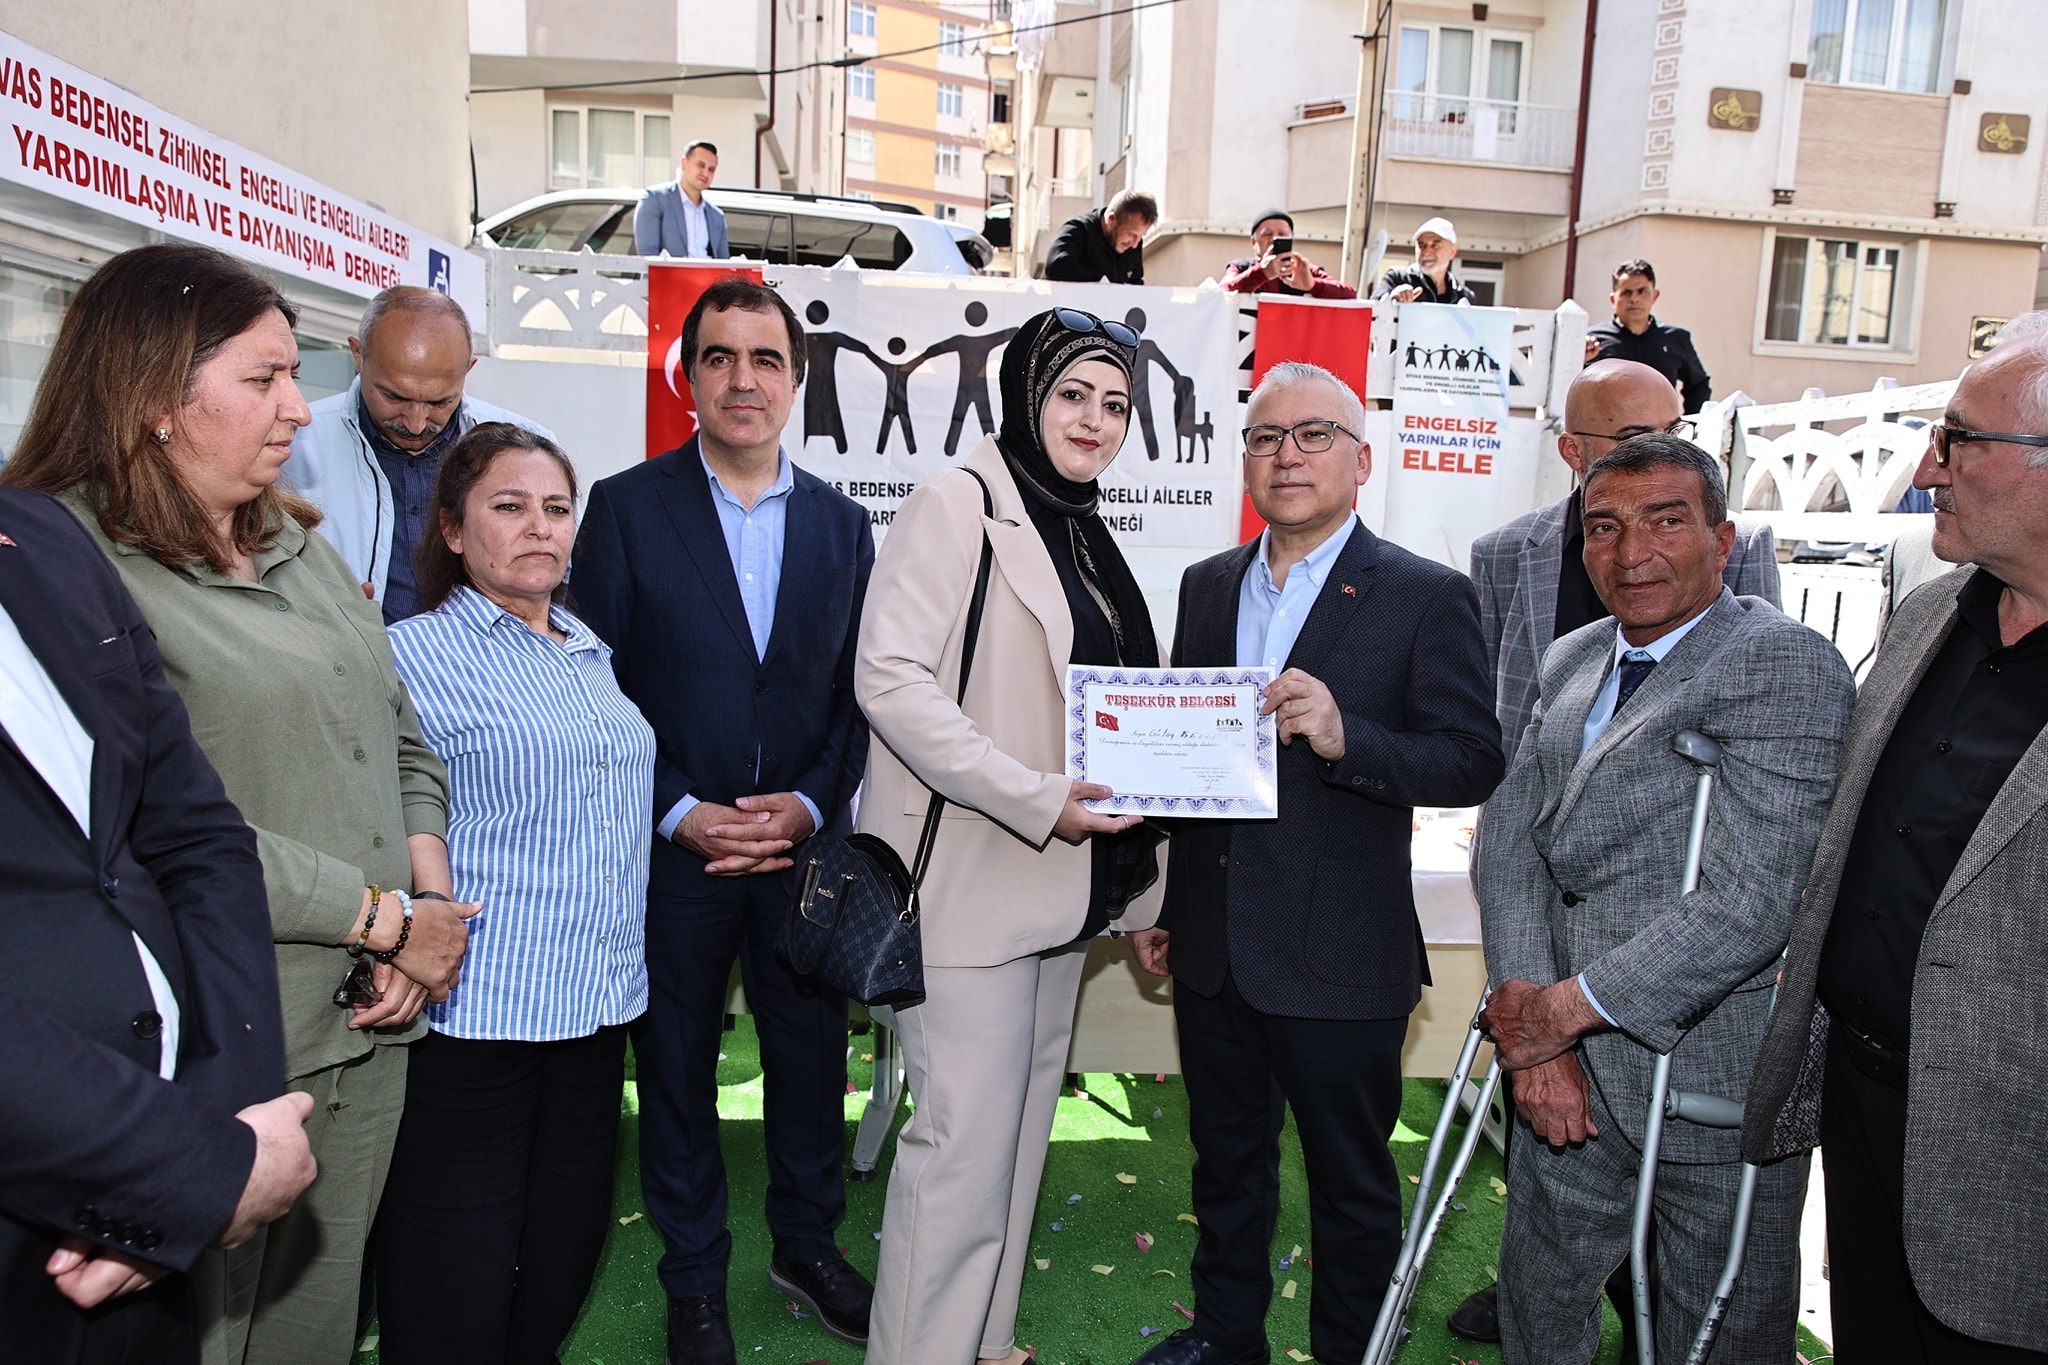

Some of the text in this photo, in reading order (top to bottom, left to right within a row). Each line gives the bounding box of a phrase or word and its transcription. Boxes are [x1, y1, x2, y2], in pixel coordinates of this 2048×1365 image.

[50, 76, 154, 157] BEDENSEL
[300, 190, 317, 224] VE
[12, 124, 200, 227] YARDIMLAŞMA
[204, 198, 233, 237] VE
[239, 210, 336, 272] DAYANIŞMA
[1404, 415, 1498, 434] ENGELSİZ
[1398, 432, 1501, 450] YARINLAR İÇİN
[1402, 448, 1493, 475] ELELE
[849, 482, 918, 498] BEDENSE
[1097, 485, 1148, 504] NGELLİ
[1152, 485, 1213, 506] AİLELER
[1105, 693, 1236, 711] TEŞEKKÜR BELGESİ
